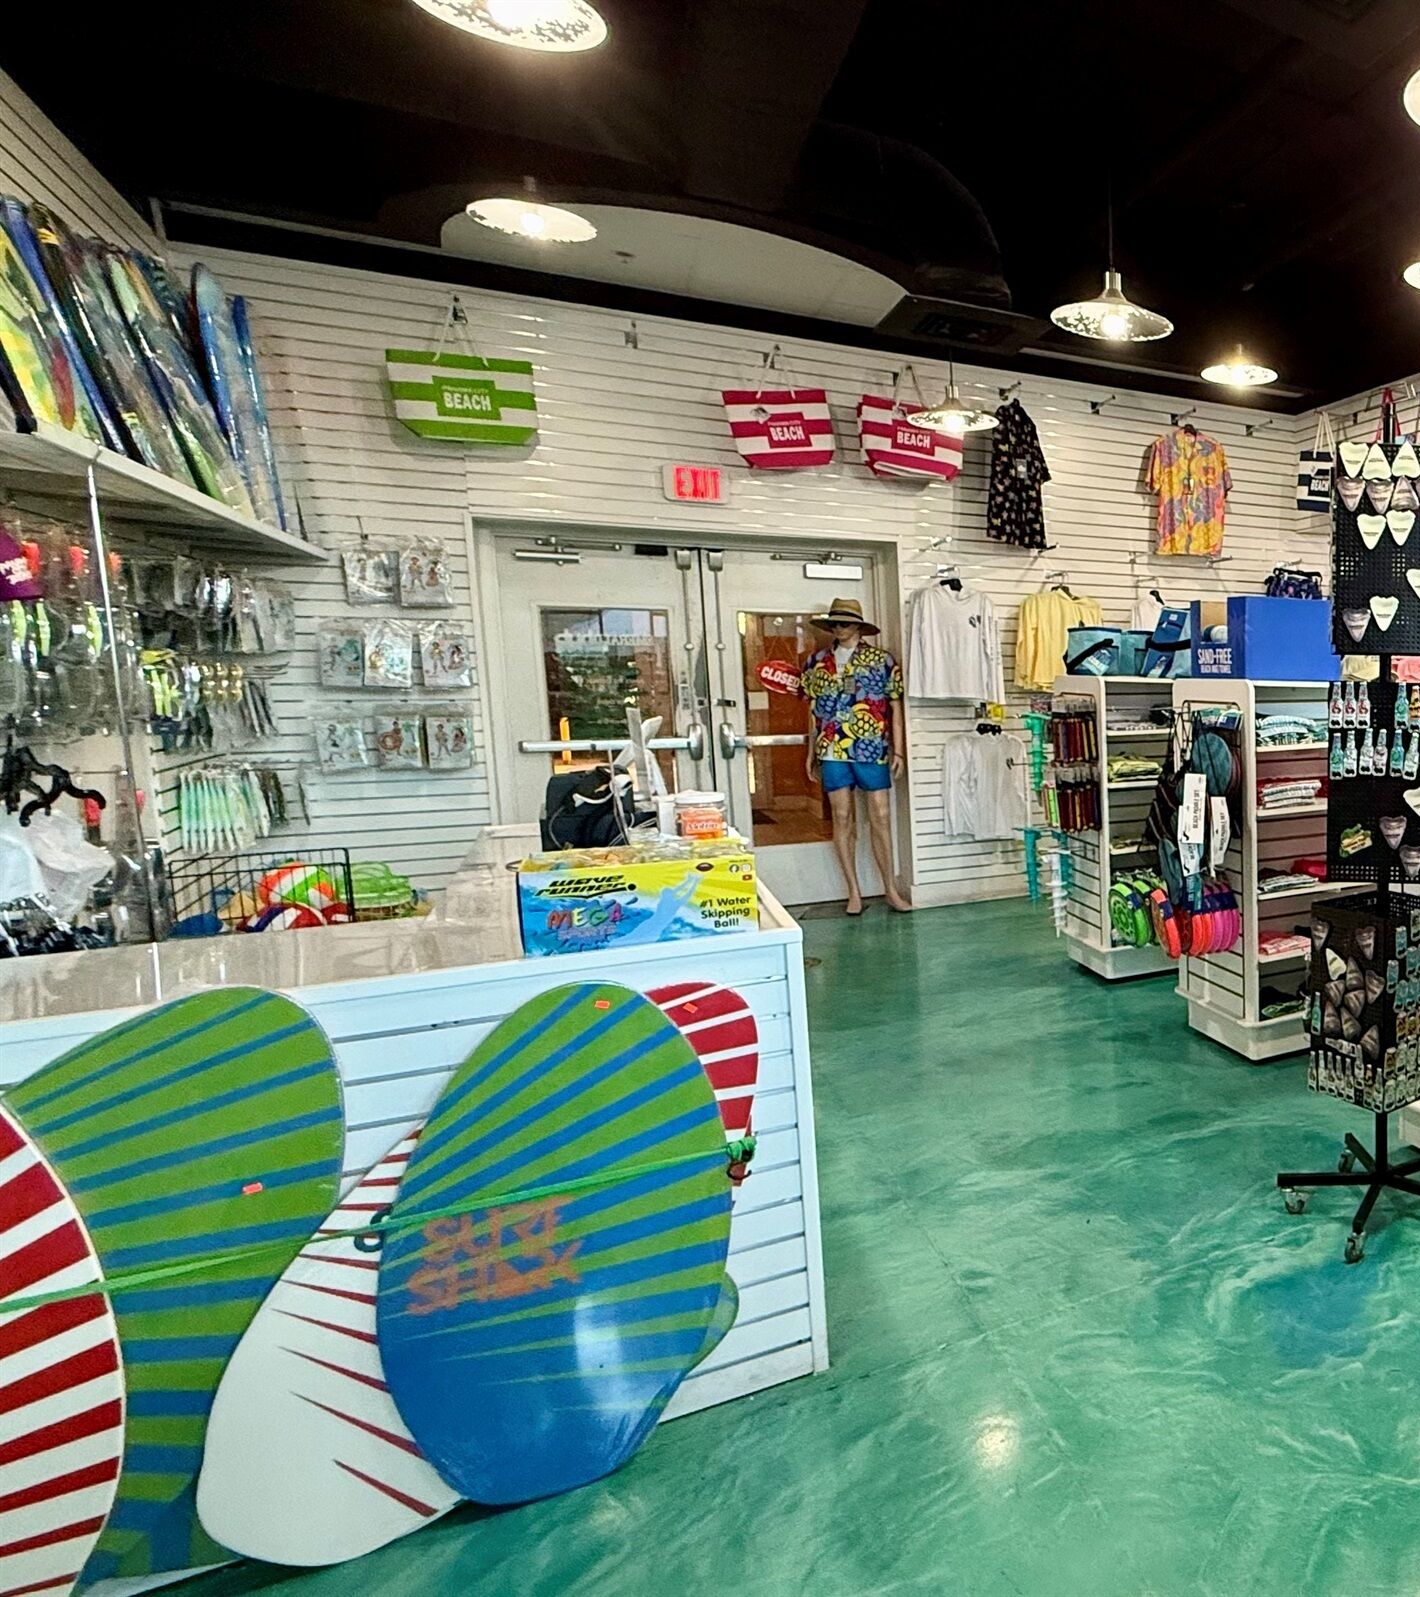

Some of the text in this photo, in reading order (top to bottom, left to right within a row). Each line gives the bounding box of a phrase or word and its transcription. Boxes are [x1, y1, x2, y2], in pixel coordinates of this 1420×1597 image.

[443, 391, 492, 412] BEACH
[769, 425, 806, 441] BEACH
[896, 431, 931, 449] BEACH
[674, 465, 721, 499] EXIT
[1197, 647, 1233, 665] SAND-FREE
[760, 665, 800, 689] CLOSED
[700, 896, 751, 908] #1 Water
[548, 902, 622, 930] MEGA
[701, 907, 750, 919] Skipping
[714, 918, 739, 928] Ball!
[421, 1195, 580, 1265] SURF
